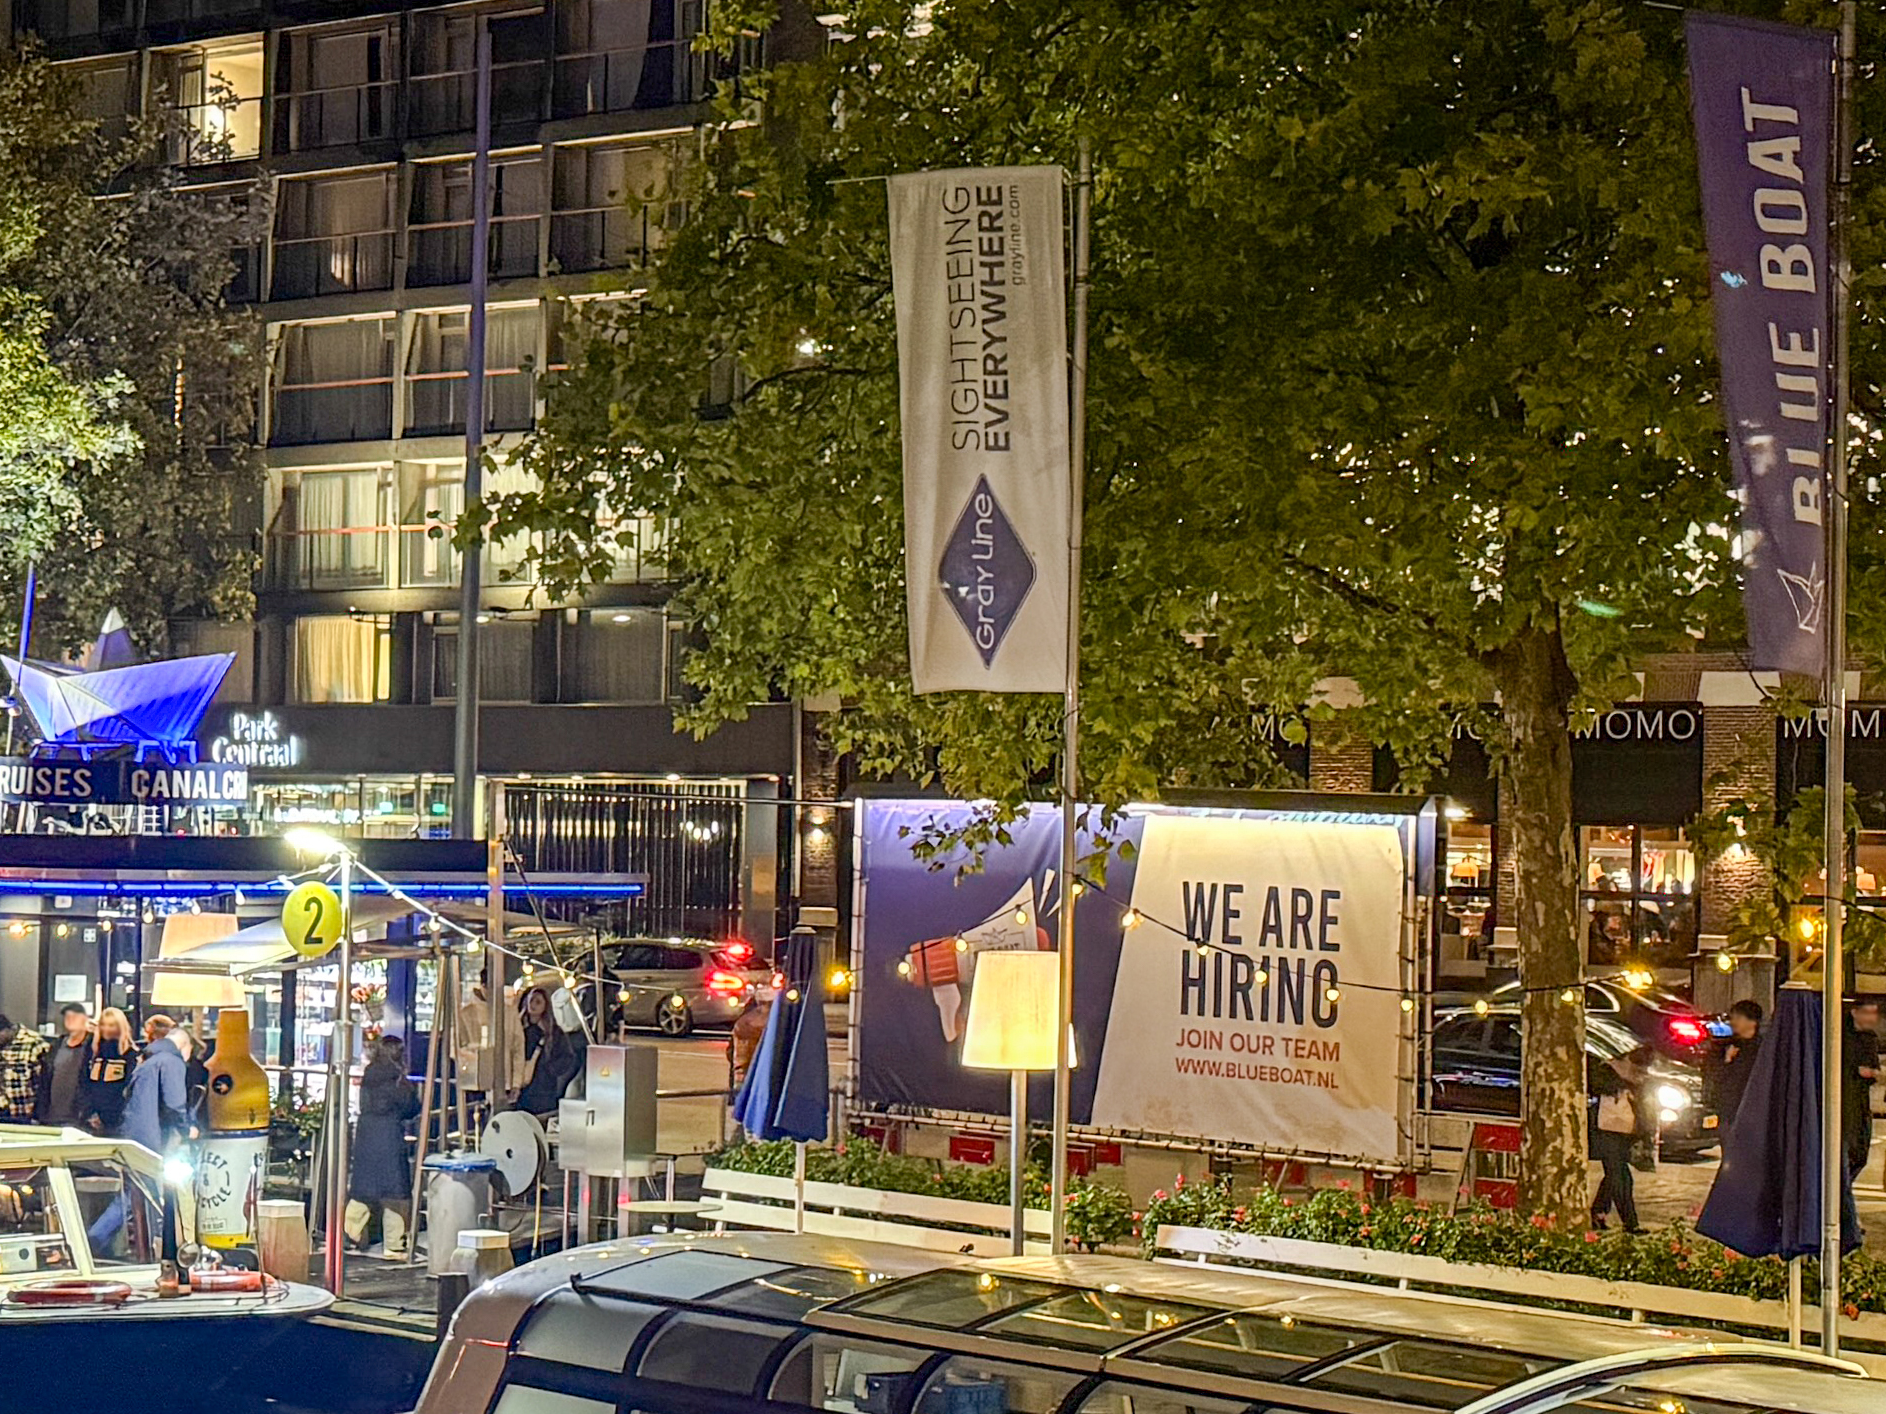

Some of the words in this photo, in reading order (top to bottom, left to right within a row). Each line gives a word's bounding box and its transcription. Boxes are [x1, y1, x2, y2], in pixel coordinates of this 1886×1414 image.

[1741, 86, 1817, 293] BOAT
[1008, 185, 1026, 286] grayline.com
[942, 186, 980, 452] SIGHTSEEING
[976, 185, 1011, 454] EVERYWHERE
[1768, 321, 1822, 526] BLUE
[211, 735, 298, 766] Centraal
[233, 710, 278, 741] Park
[1575, 709, 1696, 740] MOMO
[131, 769, 221, 799] CANAL
[304, 897, 324, 945] 2
[1182, 881, 1244, 946] WE
[1258, 886, 1341, 952] ARE
[1180, 949, 1339, 1029] HIRING
[1175, 1028, 1223, 1051] JOIN
[1229, 1032, 1275, 1056] OUR
[1282, 1037, 1340, 1063] TEAM
[1175, 1057, 1339, 1089] WWW.BLUEBOAT.NL
